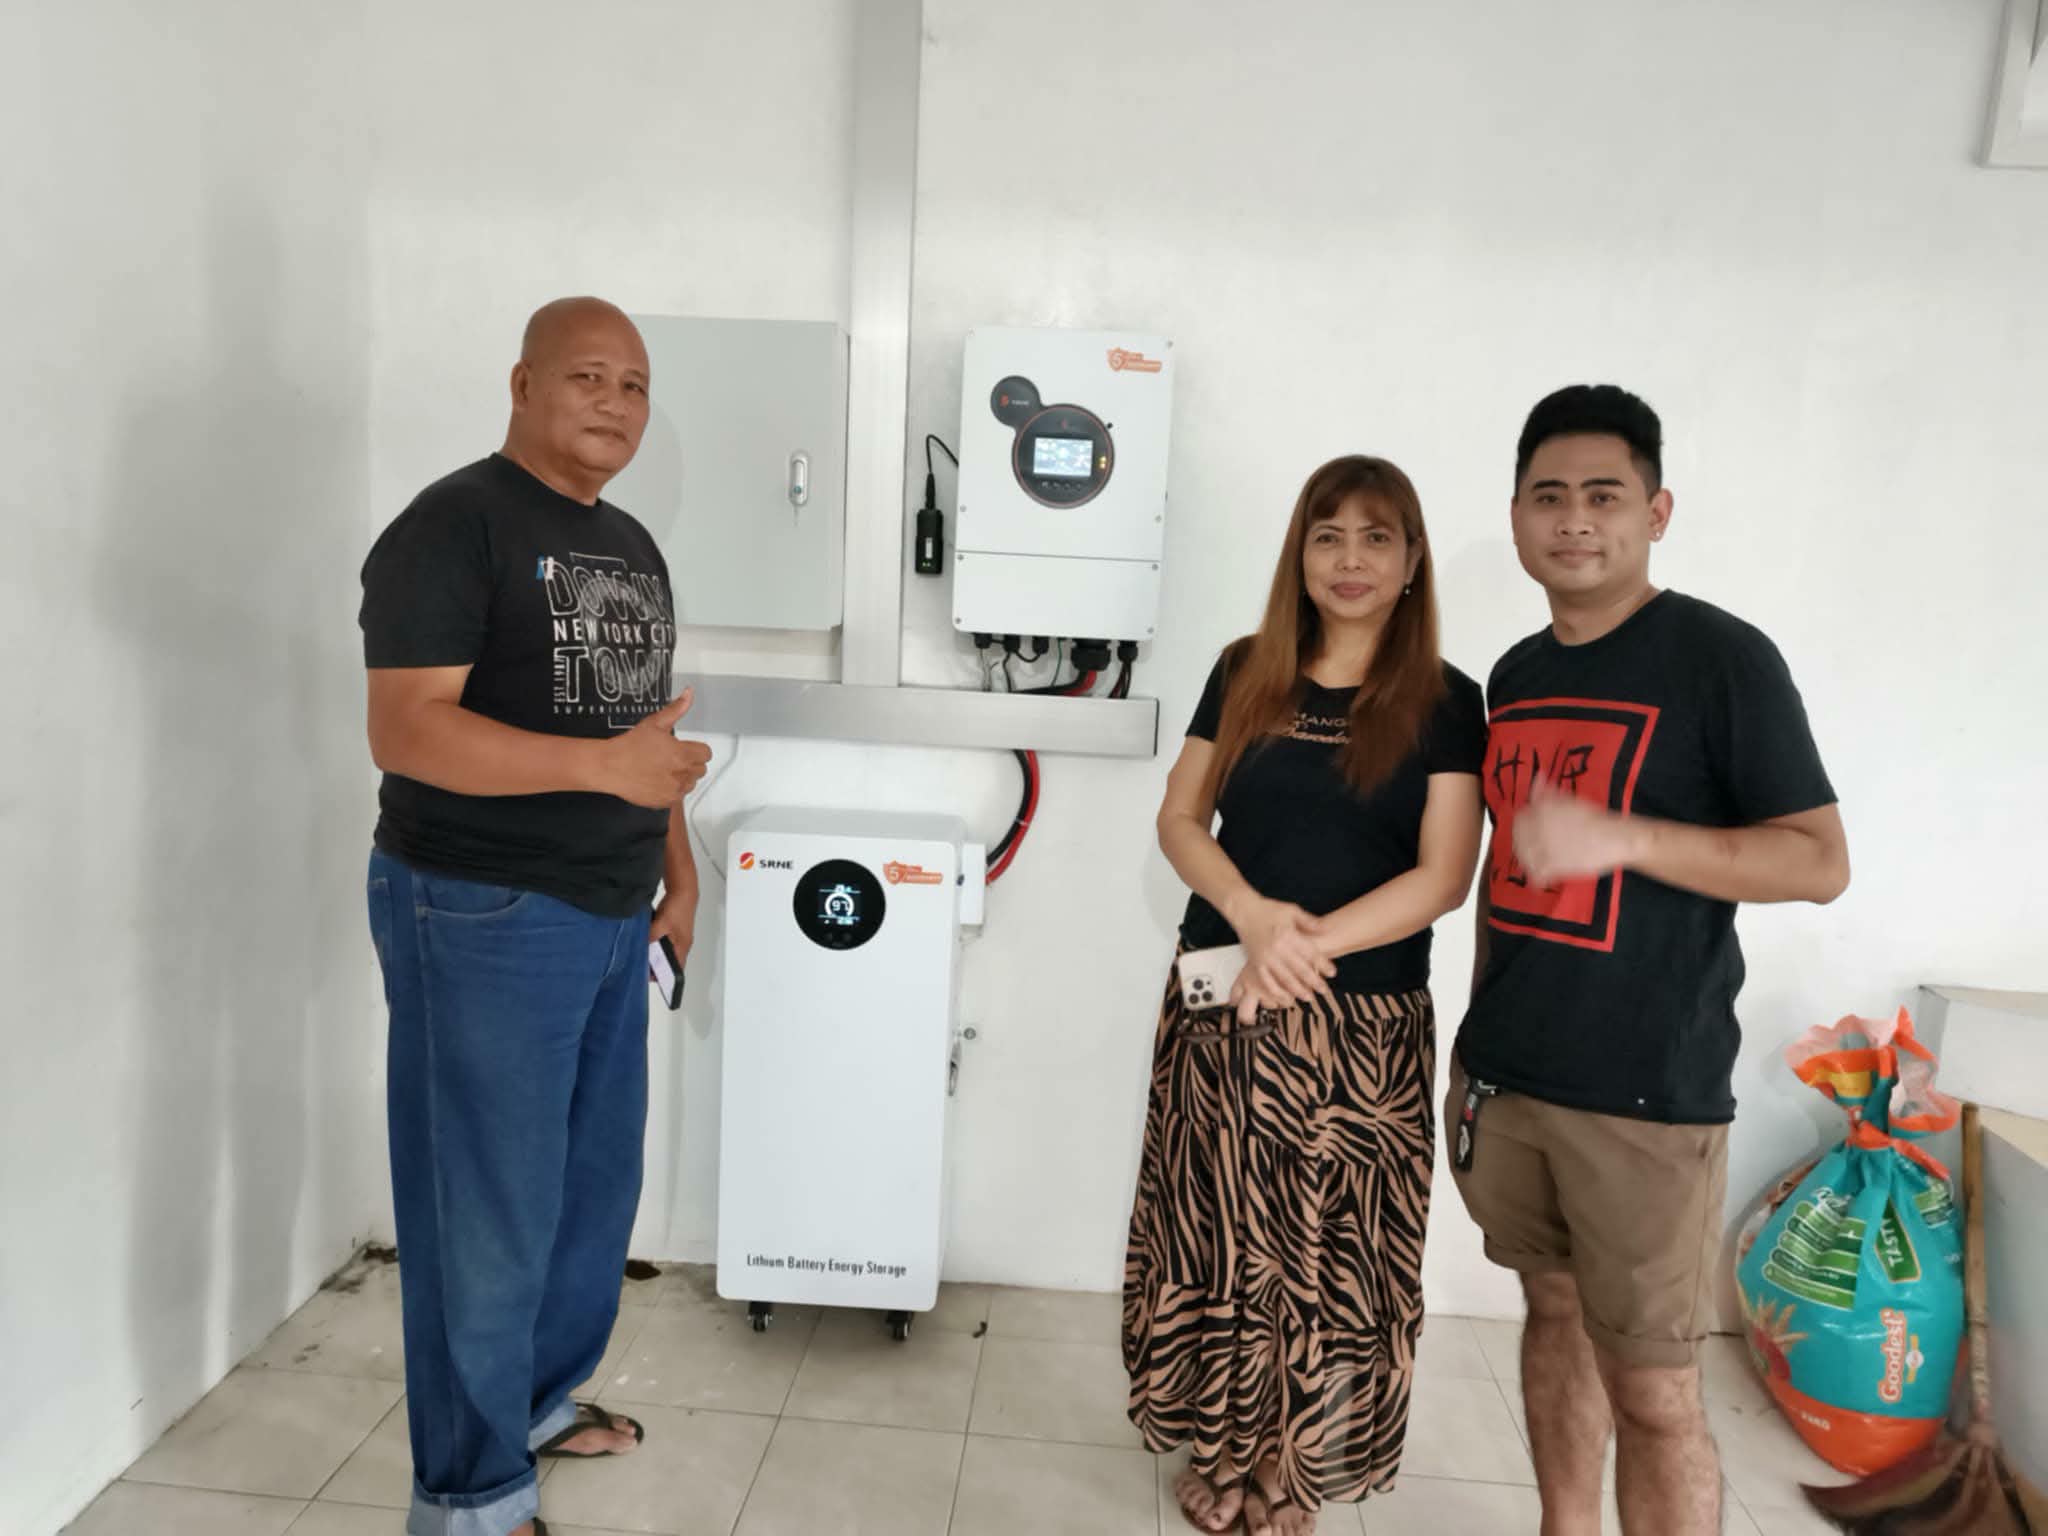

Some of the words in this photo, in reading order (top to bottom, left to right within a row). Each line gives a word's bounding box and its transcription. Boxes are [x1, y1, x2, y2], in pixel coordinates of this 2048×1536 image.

[553, 619, 599, 642] NEW
[602, 622, 645, 645] YORK
[759, 859, 794, 870] SRNE
[1880, 1218, 1904, 1269] TASTY
[747, 1253, 785, 1268] Lithium
[787, 1255, 826, 1273] Battery
[828, 1258, 864, 1275] Energy
[866, 1260, 907, 1279] Storage
[1879, 1314, 1906, 1402] Goodest
